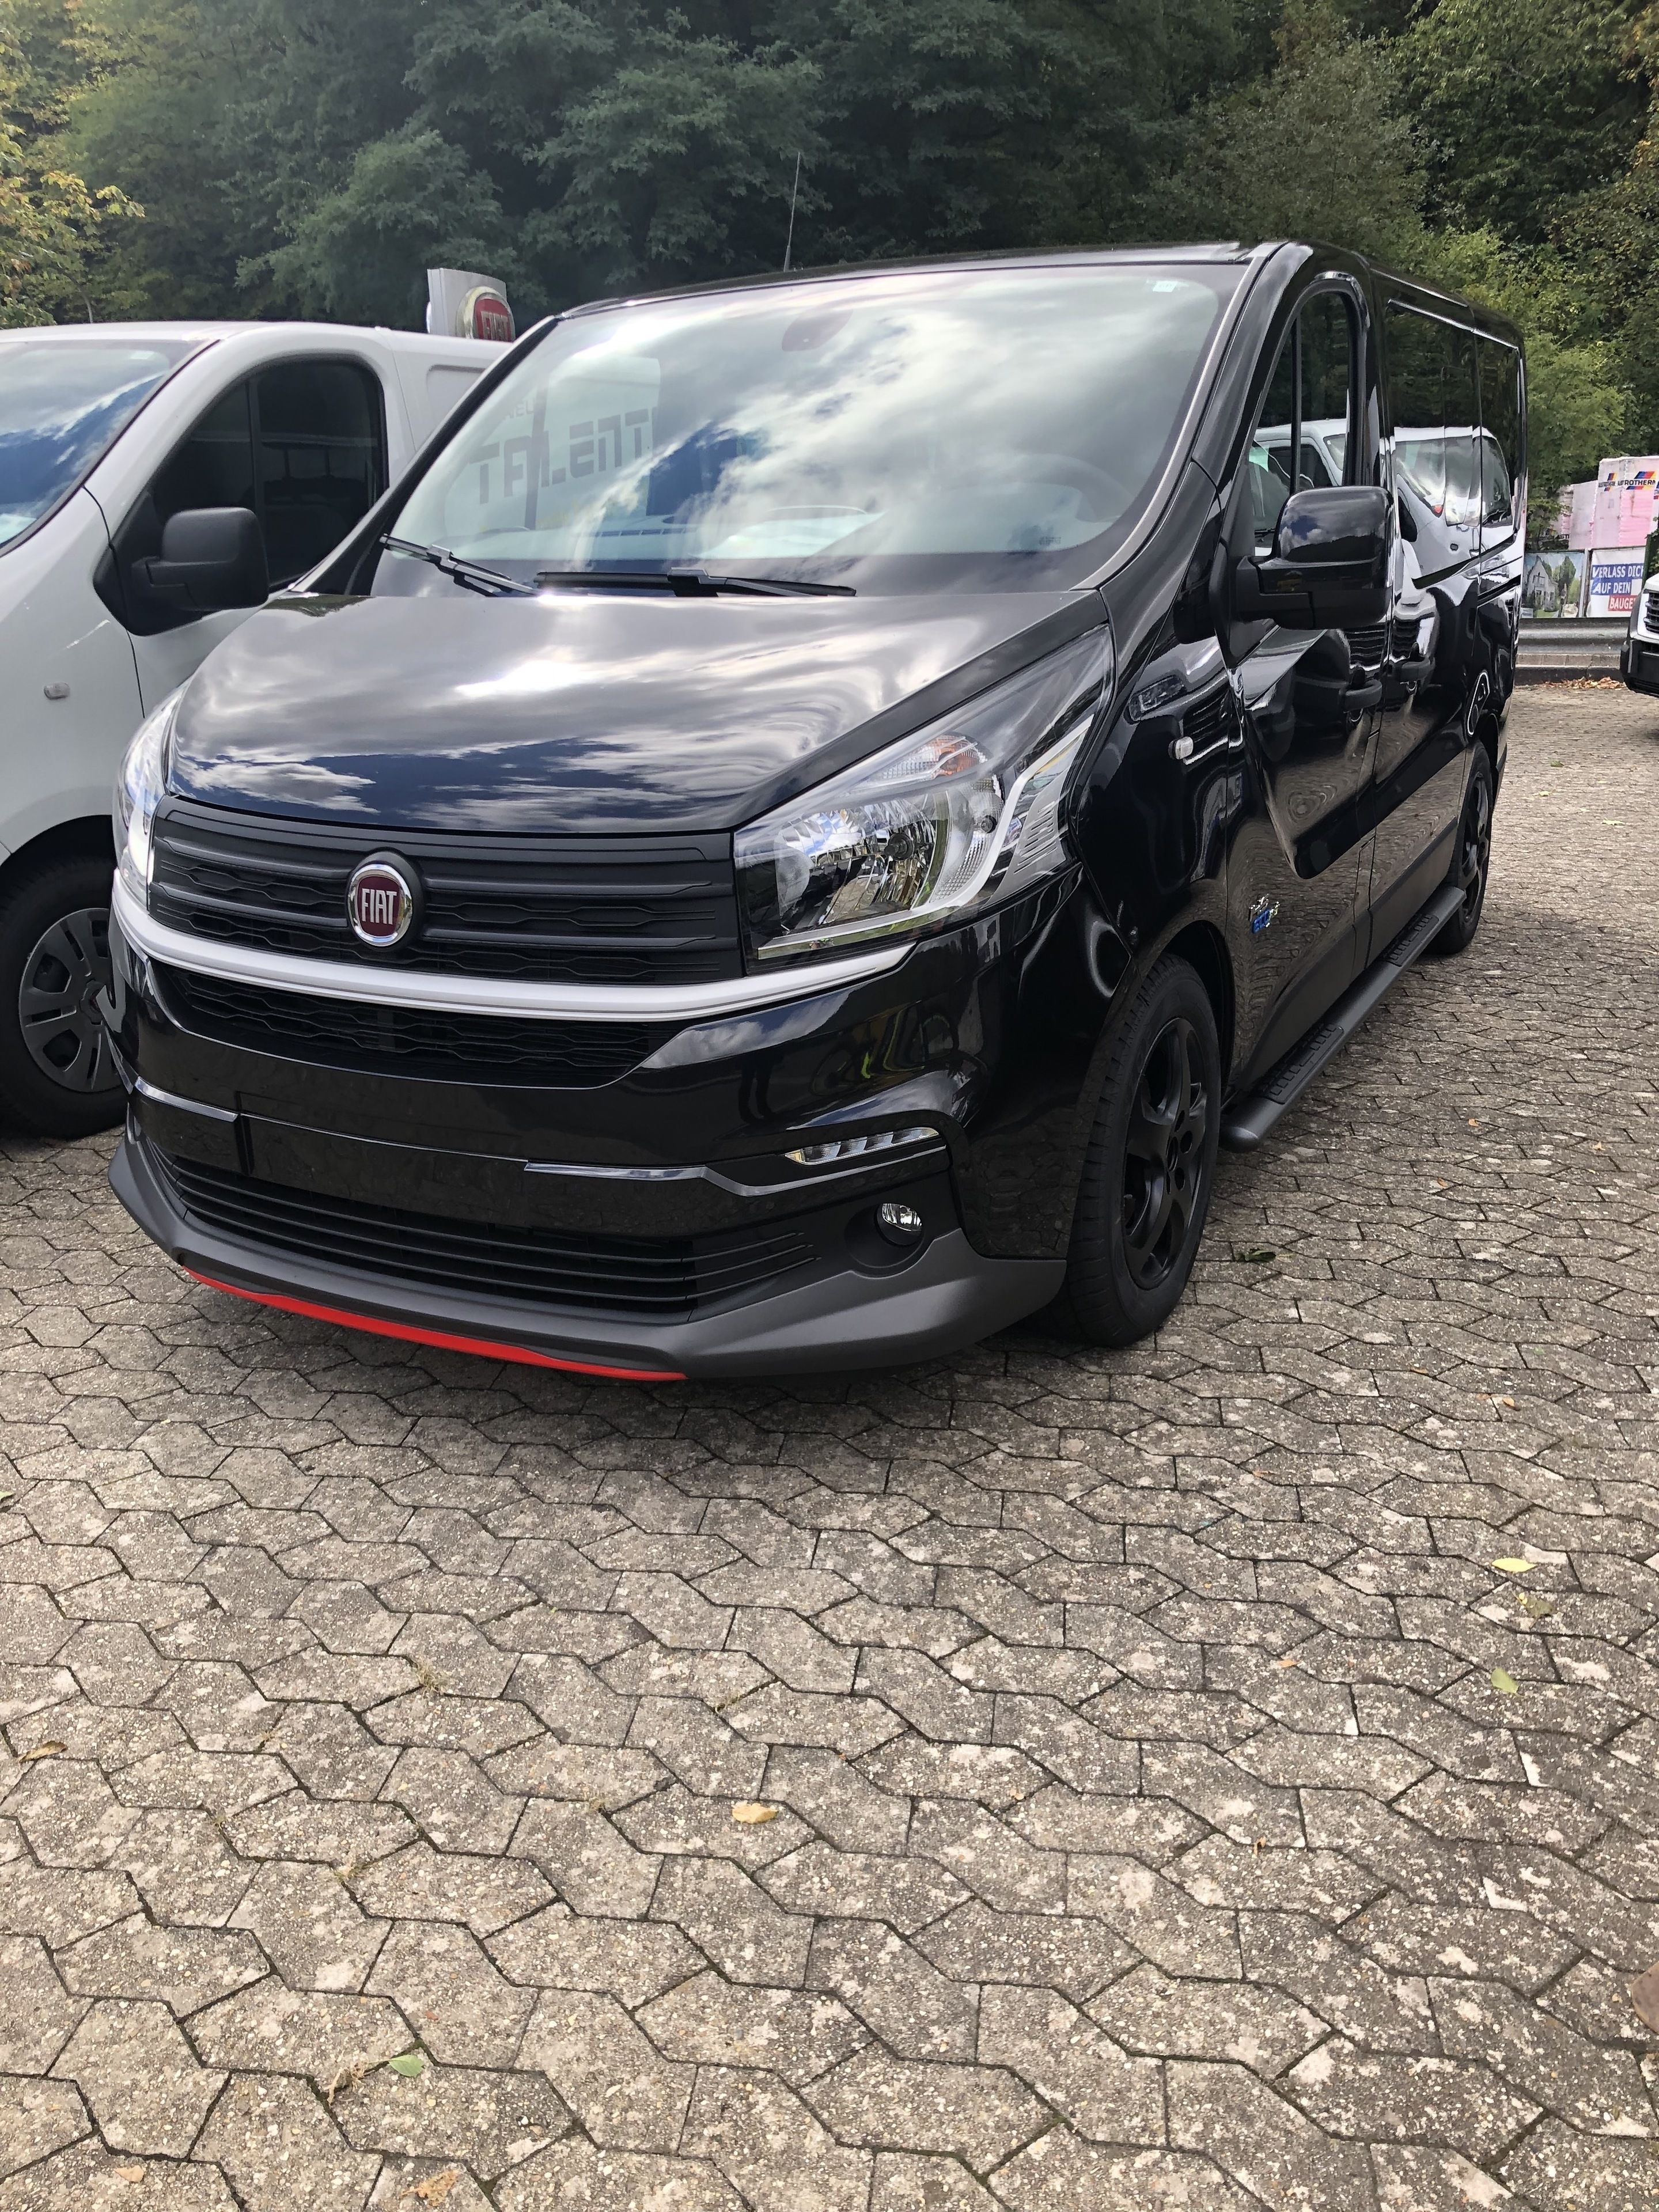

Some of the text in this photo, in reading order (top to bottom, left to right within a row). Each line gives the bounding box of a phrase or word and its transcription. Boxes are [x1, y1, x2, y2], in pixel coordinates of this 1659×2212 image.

[1592, 566, 1626, 578] VERLASS
[1592, 582, 1631, 594] AUF DEIN
[1609, 597, 1635, 609] BAUGE
[362, 888, 397, 925] FIAT
